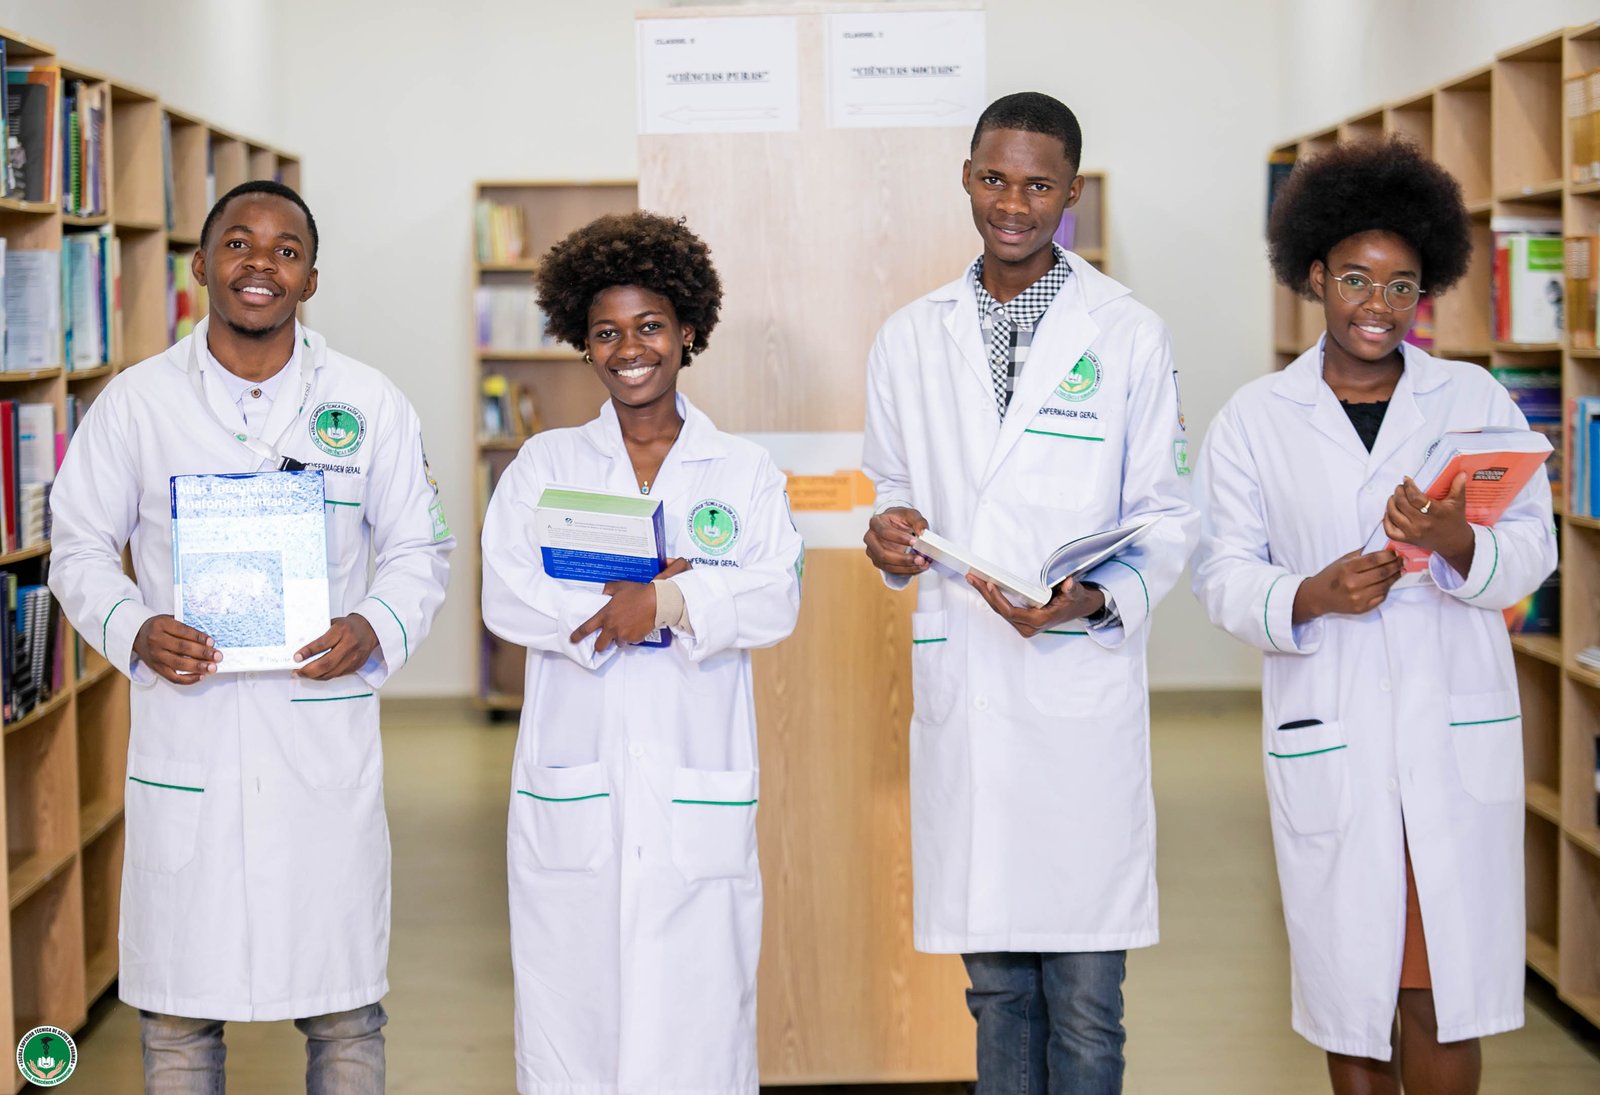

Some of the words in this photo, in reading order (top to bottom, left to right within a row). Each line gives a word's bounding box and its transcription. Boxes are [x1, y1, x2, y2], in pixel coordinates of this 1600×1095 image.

[1039, 407, 1078, 418] ENFERMAGEM
[1080, 411, 1098, 420] GERAL
[345, 466, 361, 474] GERAL
[178, 483, 208, 496] Atlas
[284, 481, 300, 492] de
[178, 497, 238, 510] Anatomia
[240, 496, 293, 508] Humana
